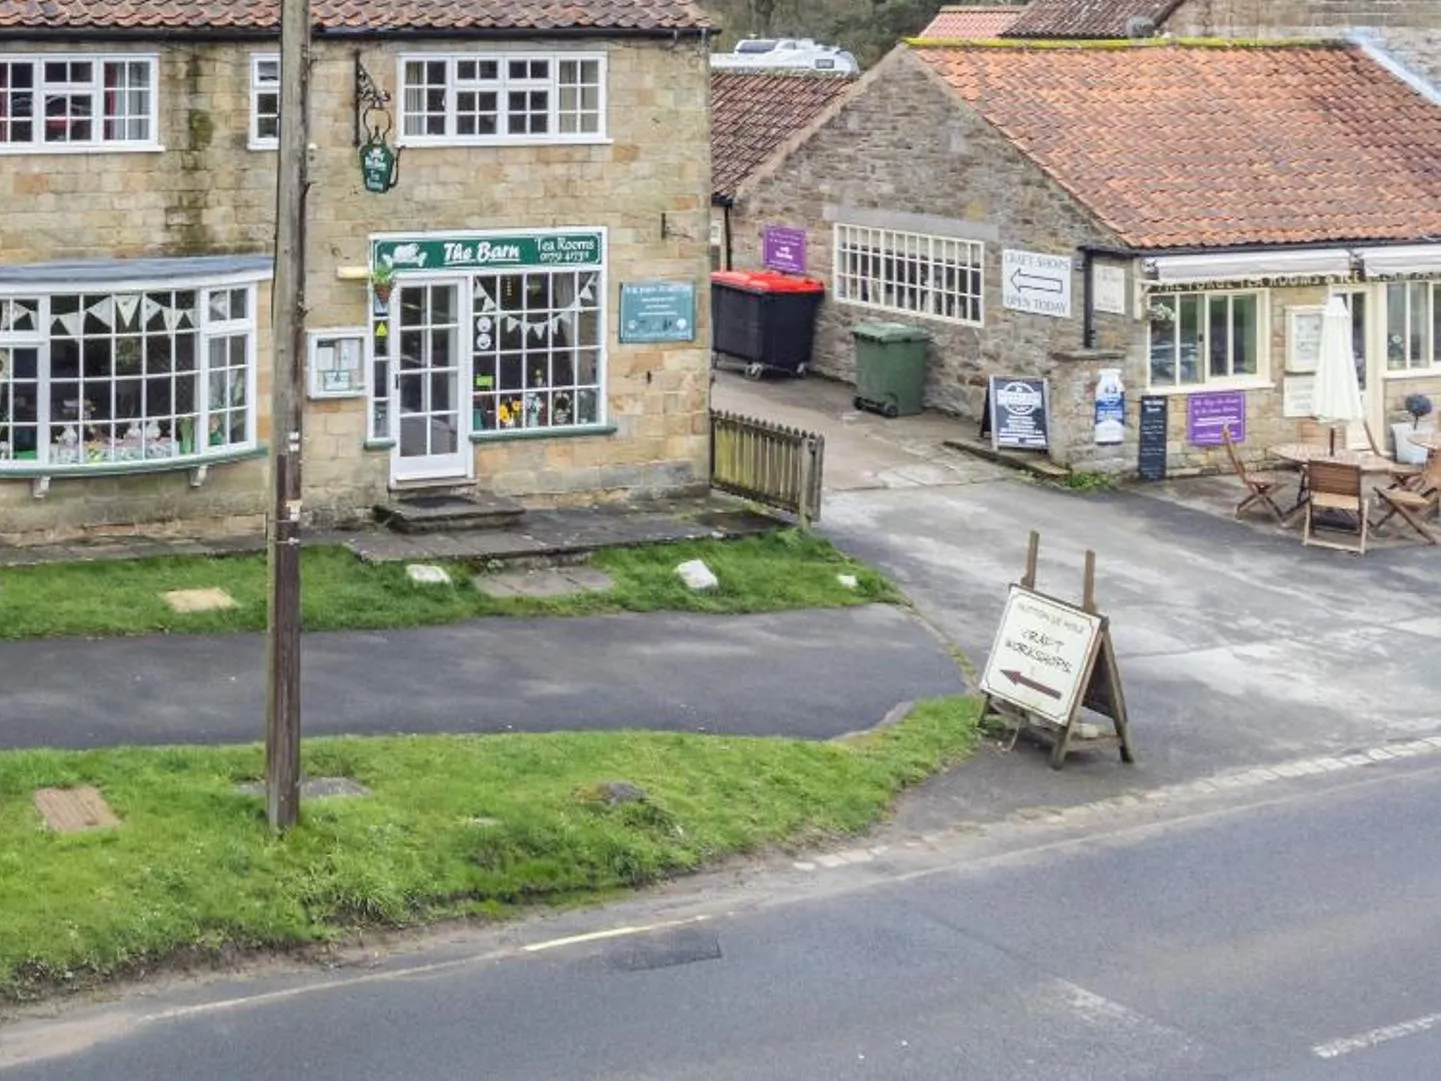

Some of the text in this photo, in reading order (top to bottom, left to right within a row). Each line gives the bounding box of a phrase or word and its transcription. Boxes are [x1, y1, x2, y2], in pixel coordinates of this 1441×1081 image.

[443, 241, 519, 263] The Barn
[534, 237, 594, 252] Tea Rooms
[1004, 252, 1070, 272] CRAFT SHOPS
[1270, 273, 1319, 288] ROOMS
[1006, 295, 1068, 314] OPEN TODAY
[1021, 630, 1065, 653] CRAFT
[1005, 640, 1072, 673] WORKSHOPS
